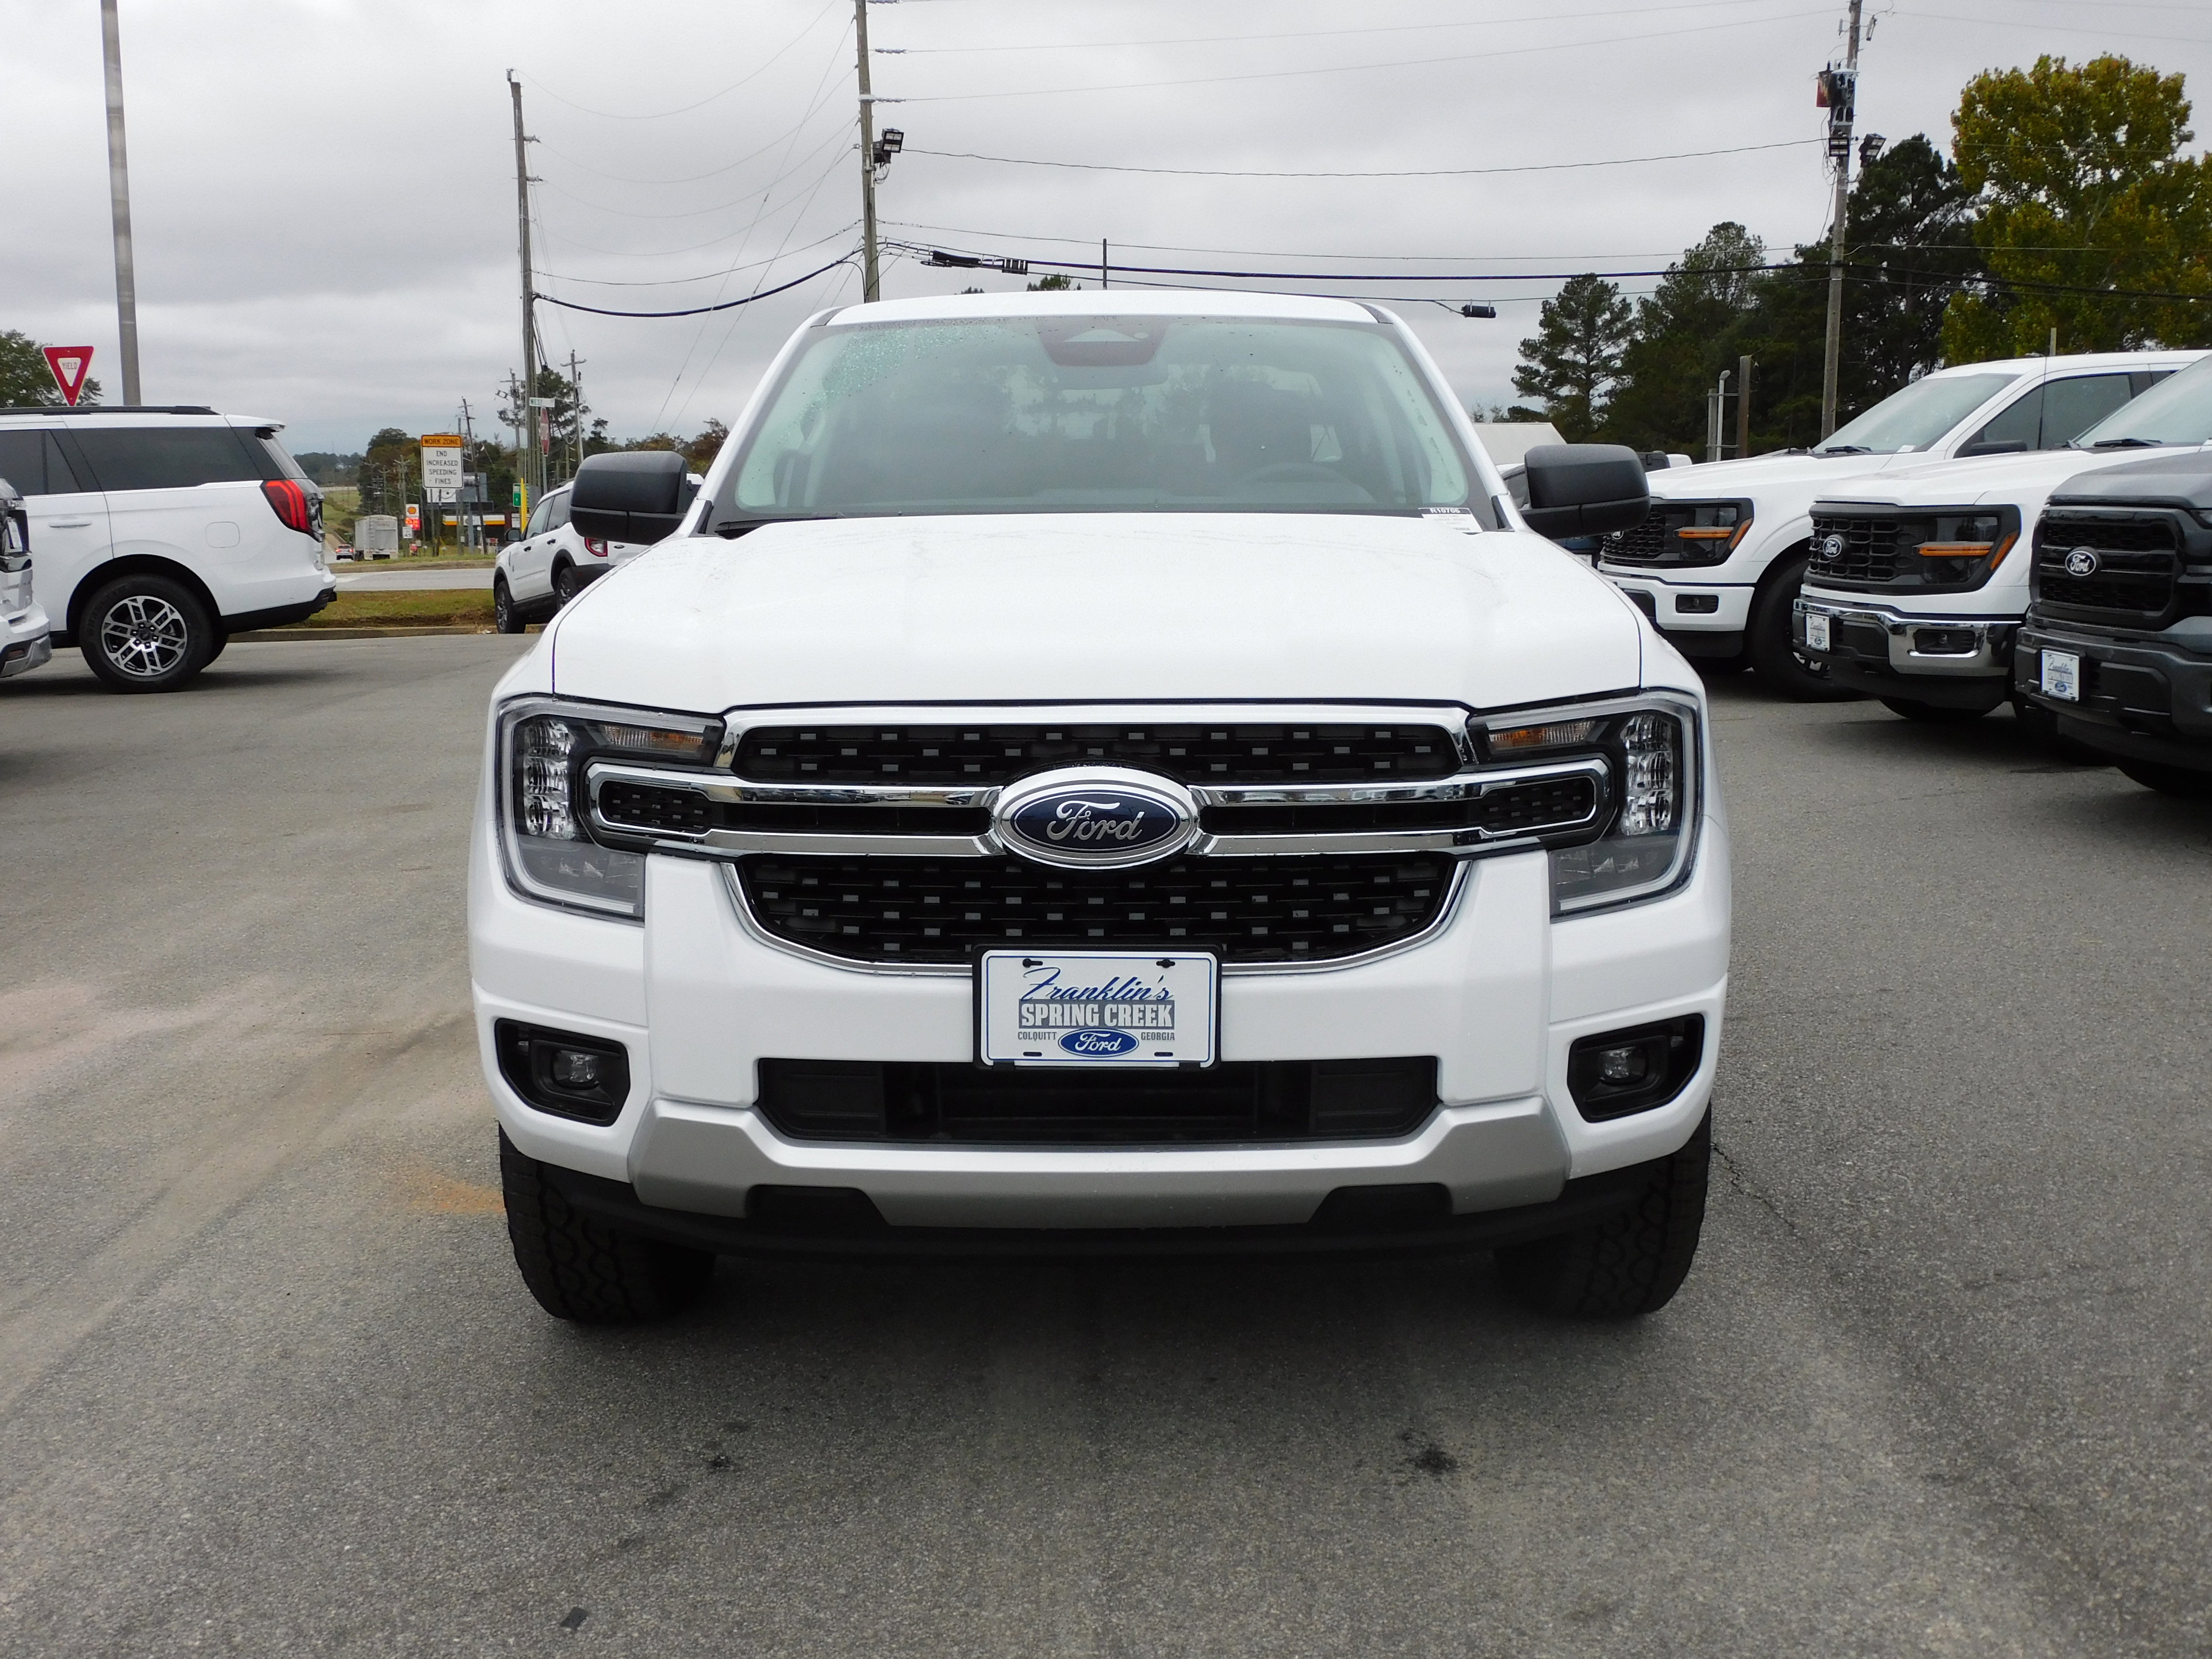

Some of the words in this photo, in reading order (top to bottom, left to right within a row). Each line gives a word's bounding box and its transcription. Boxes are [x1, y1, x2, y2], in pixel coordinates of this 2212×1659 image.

[2070, 553, 2090, 572] Ford
[1046, 800, 1145, 841] Ford
[1021, 967, 1174, 1001] Franklin's
[1021, 1003, 1100, 1027] SPRING
[1104, 1004, 1173, 1027] CREEK
[1018, 1032, 1057, 1041] COLQUITT
[1075, 1032, 1122, 1051] Ford
[1141, 1032, 1175, 1041] GEORGIA
